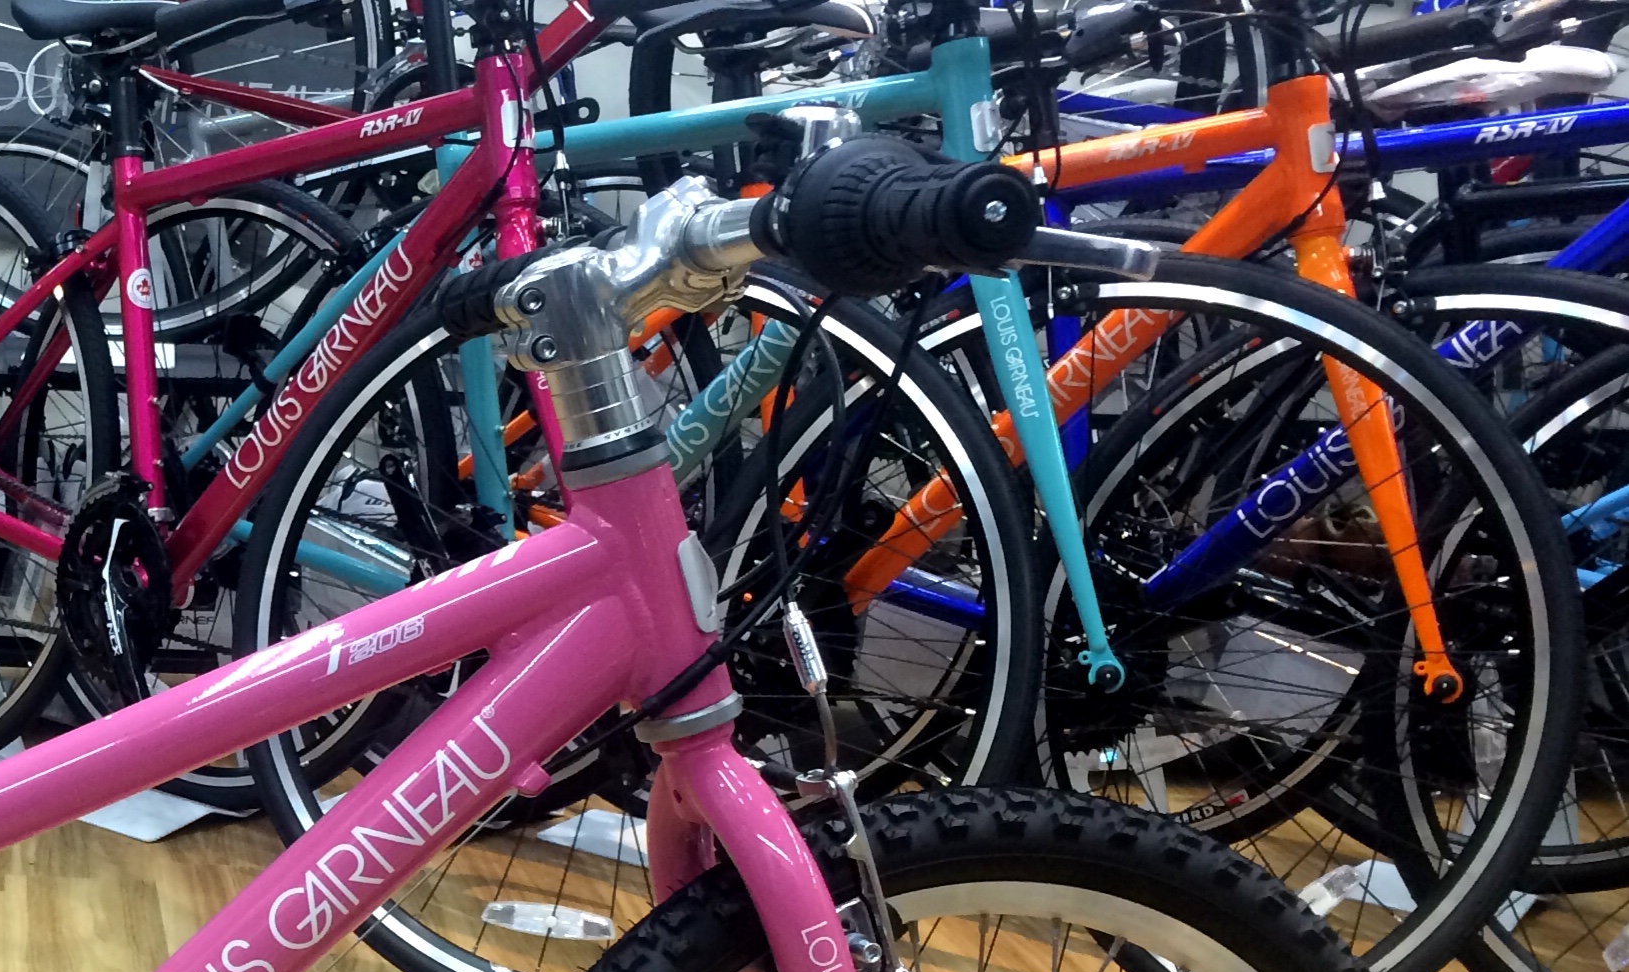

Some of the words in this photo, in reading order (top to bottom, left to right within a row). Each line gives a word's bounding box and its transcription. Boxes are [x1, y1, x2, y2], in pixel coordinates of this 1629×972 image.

[1474, 115, 1578, 144] RSR-IV
[225, 385, 302, 489] LOUIS
[297, 242, 414, 393] GARNEAU
[990, 296, 1018, 346] LOUIS
[1005, 347, 1037, 418] GARNEAU
[267, 716, 512, 951] GARNEAU
